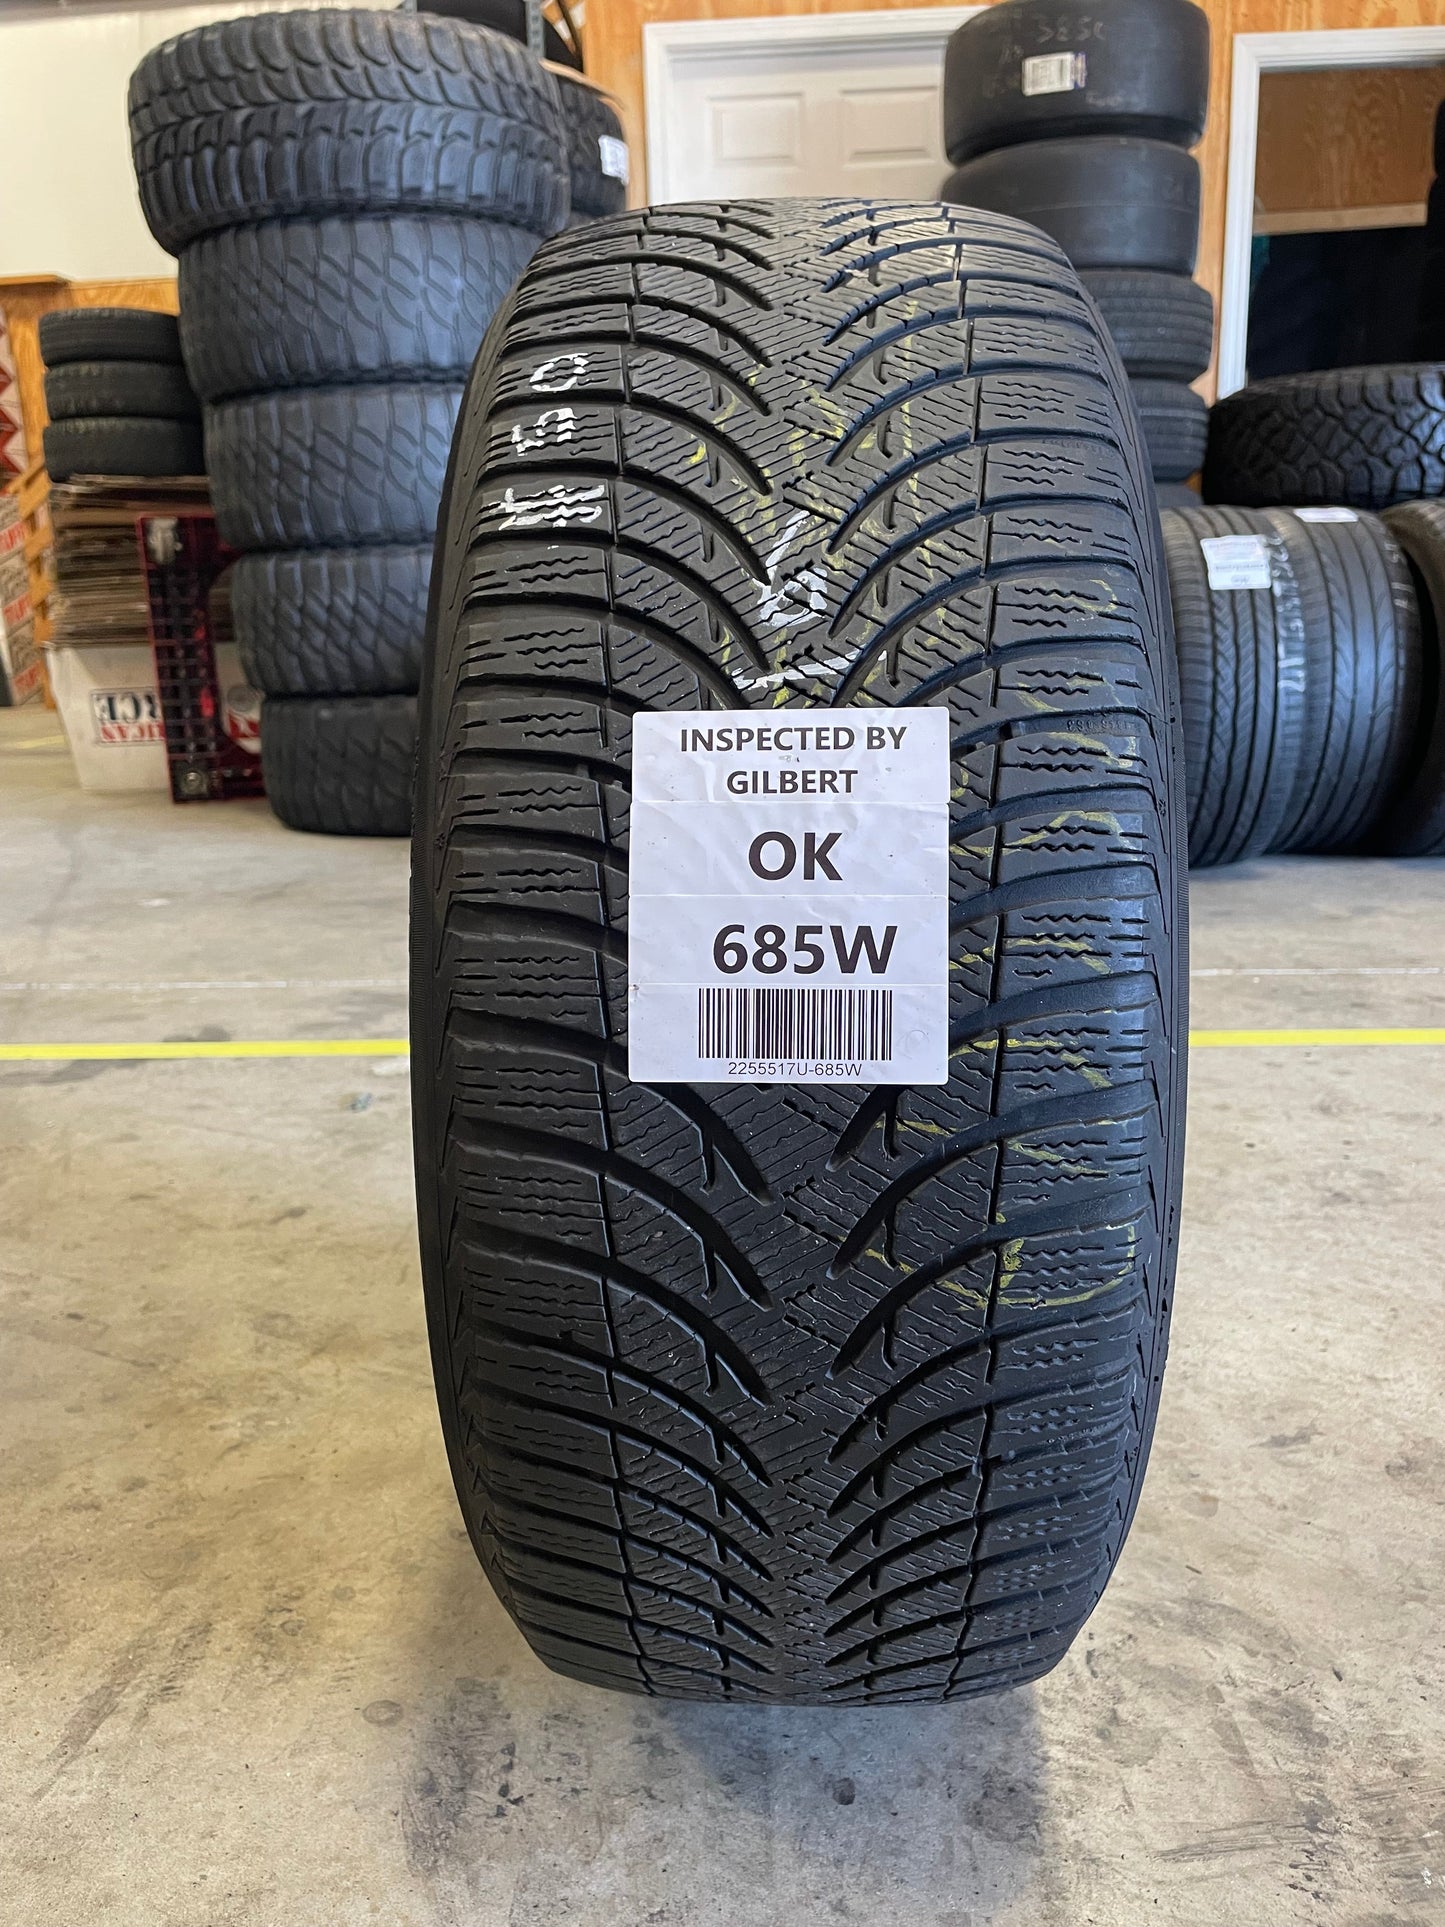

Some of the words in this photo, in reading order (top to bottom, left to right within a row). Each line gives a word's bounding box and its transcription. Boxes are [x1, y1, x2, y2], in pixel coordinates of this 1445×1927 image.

[680, 727, 855, 752] INSPECTED
[866, 726, 908, 751] BY
[726, 770, 859, 795] GILBERT
[748, 831, 844, 881] OK
[712, 923, 898, 975] 685W
[728, 1062, 862, 1077] 2255517U-685W
